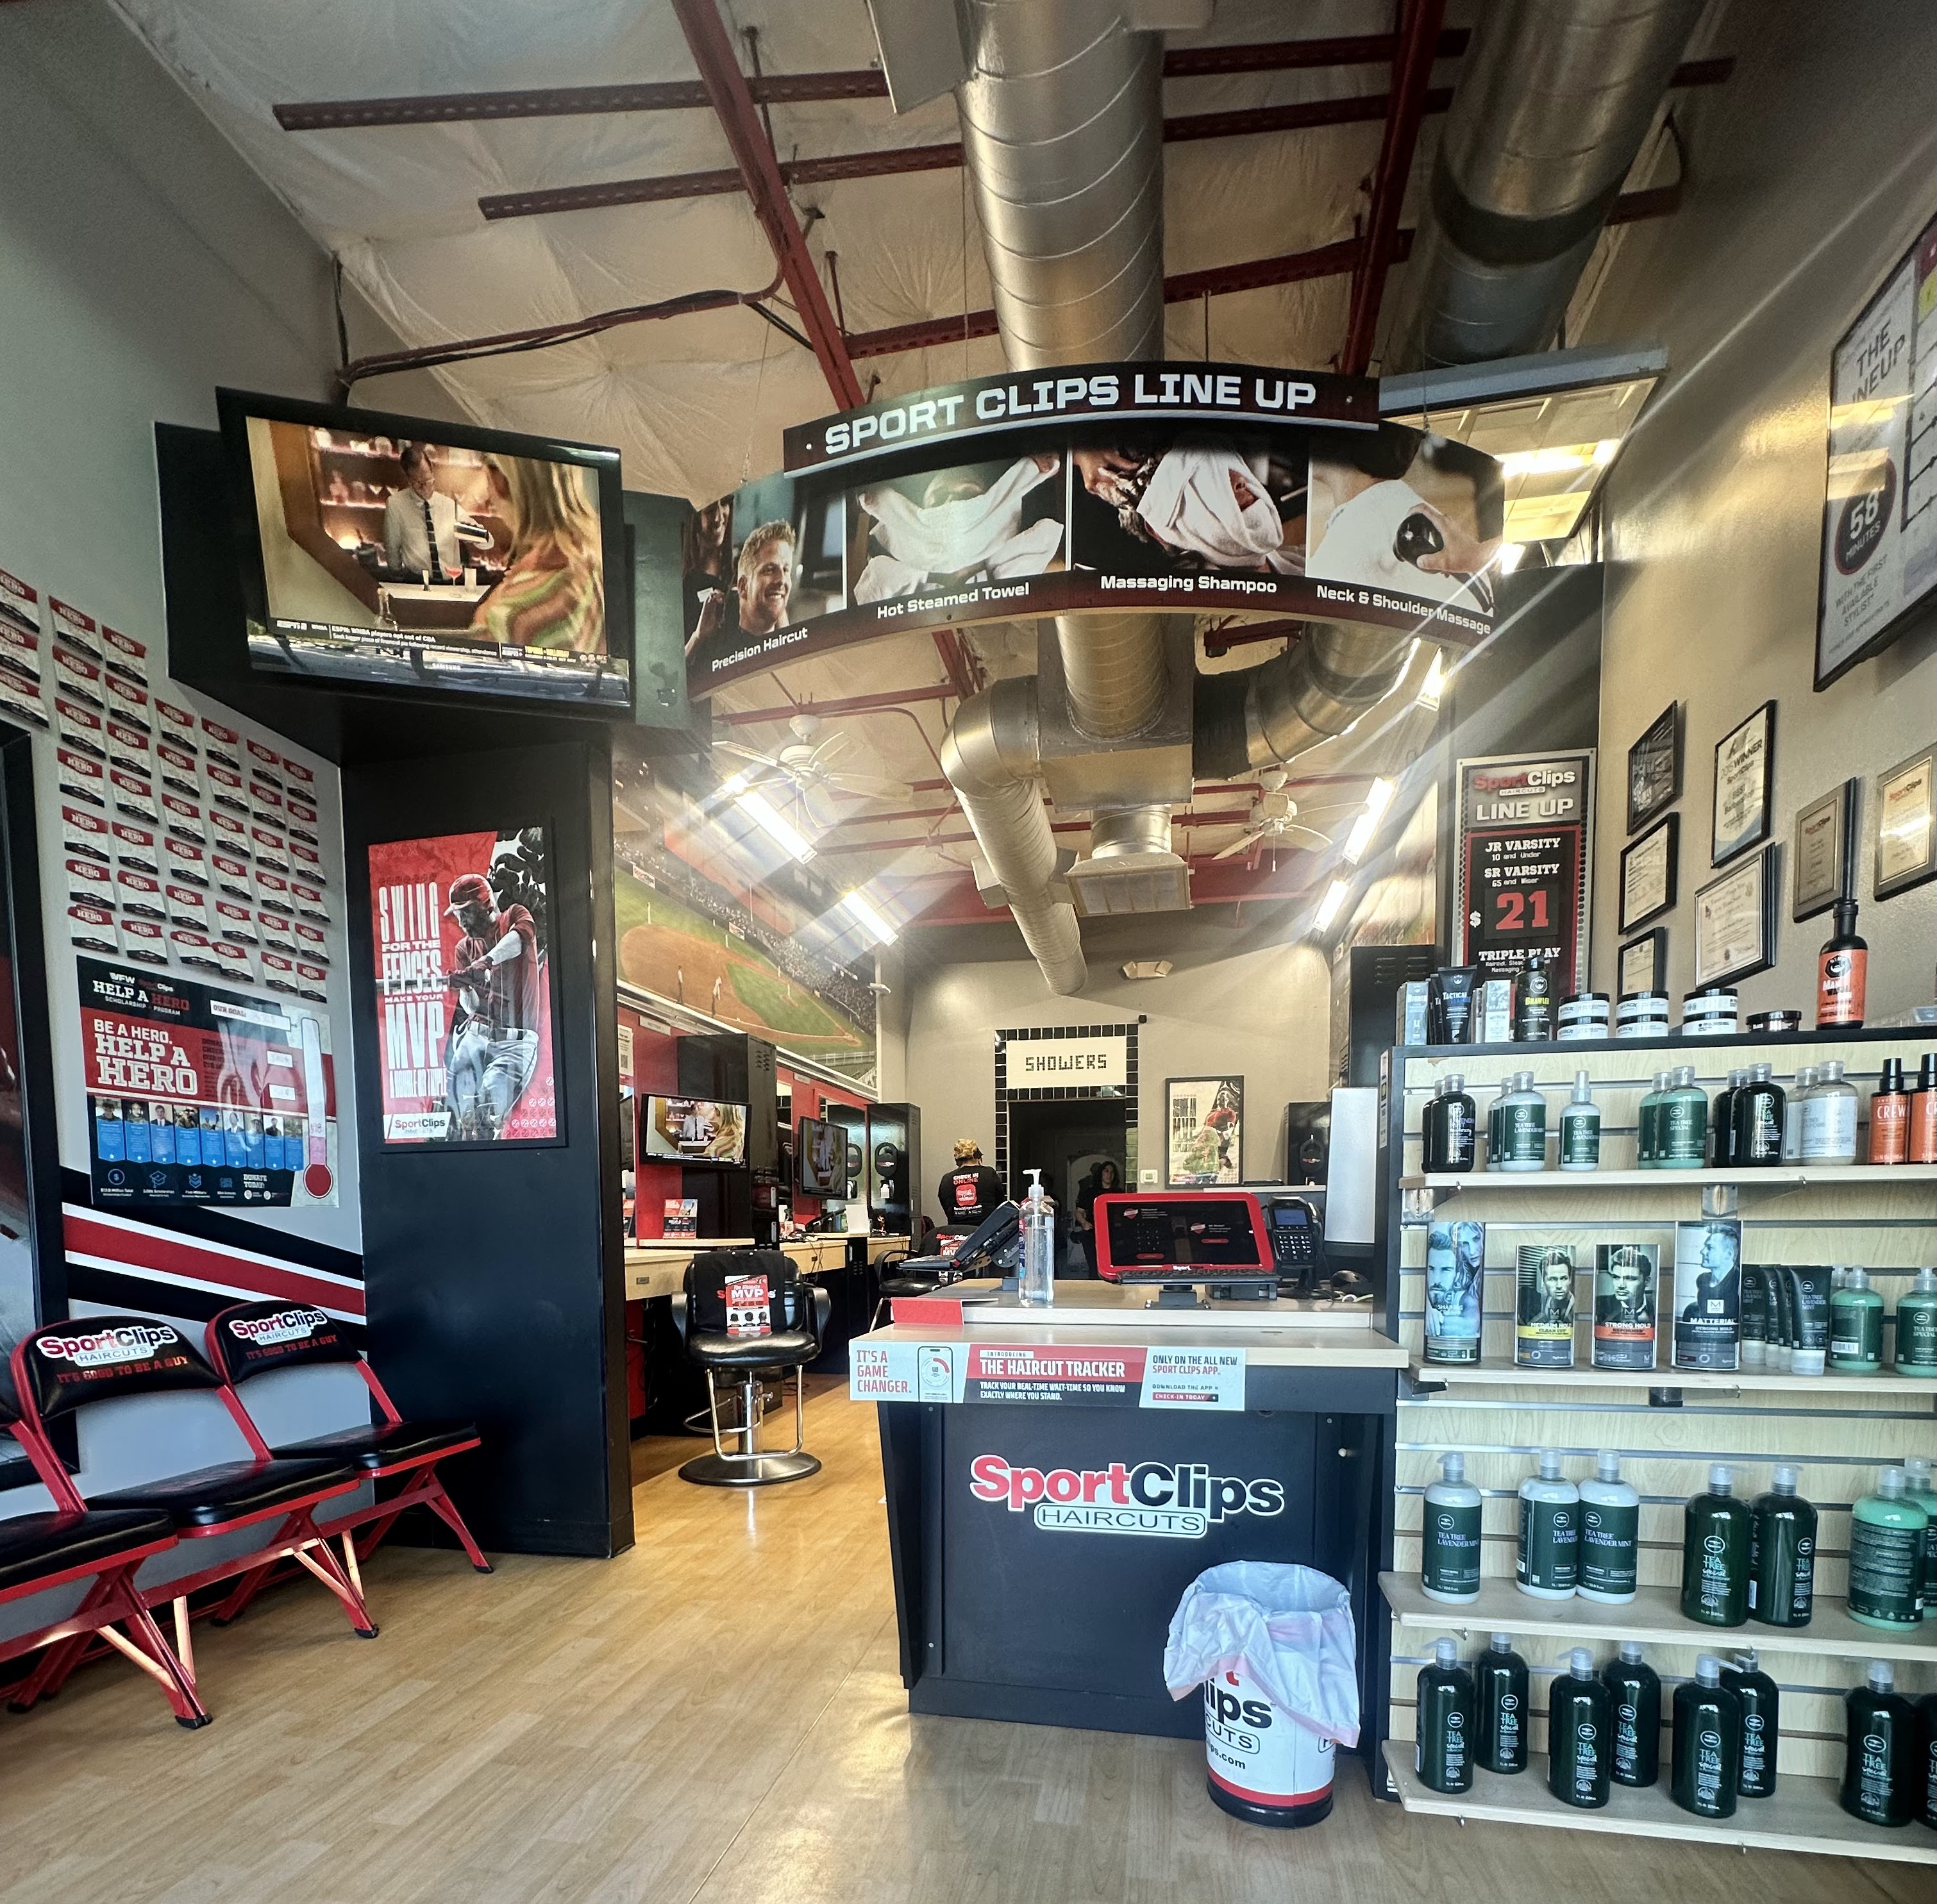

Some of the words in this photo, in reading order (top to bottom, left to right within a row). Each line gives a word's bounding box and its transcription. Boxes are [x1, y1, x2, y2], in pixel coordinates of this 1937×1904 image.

[1857, 319, 1891, 376] THE
[825, 396, 964, 455] SPORT
[976, 375, 1119, 419] CLIPS
[1134, 374, 1241, 405] LINE
[1255, 382, 1316, 410] UP
[1846, 519, 1881, 562] MINUTES
[1100, 576, 1194, 591] Massaging
[1198, 576, 1277, 594] Shampoo
[877, 602, 904, 619] Hot
[907, 588, 978, 613] Steamed
[982, 582, 1030, 601] Towel
[1316, 585, 1355, 603] Neck
[1359, 592, 1370, 604] &
[1373, 594, 1434, 617] Shoulder
[1436, 608, 1491, 635] Massage
[712, 643, 761, 672] Precision
[764, 627, 808, 651] Haircut
[1734, 739, 1763, 767] WINNER
[1475, 771, 1575, 792] SportClips
[1477, 802, 1529, 821] LINE
[1539, 799, 1573, 815] UP
[1485, 841, 1501, 852] JR
[1505, 838, 1561, 851] VARSITY
[1484, 867, 1500, 878] SR
[1504, 864, 1559, 877] VARSITY
[379, 881, 440, 943] SWING
[1470, 911, 1481, 928] $
[1496, 890, 1548, 930] 21
[382, 941, 411, 952] FOR
[412, 939, 441, 949] THE
[1479, 950, 1524, 961] TRIPLE
[92, 980, 134, 999] HELP
[137, 989, 149, 1003] A
[151, 992, 190, 1011] HERO
[105, 995, 147, 1009] SCHOLARSHIP
[153, 1005, 181, 1016] PROGRAM
[213, 1005, 228, 1013] OUR
[94, 1019, 114, 1034] BE
[117, 1024, 128, 1037] A
[131, 1026, 173, 1044] HERO.
[94, 1033, 165, 1062] HELP
[170, 1046, 190, 1067] A
[1026, 1054, 1107, 1071] SHOWERS
[96, 1055, 198, 1096] HERO
[1877, 1101, 1906, 1119] CREW
[394, 1118, 446, 1130] SportClips
[731, 1289, 764, 1298] MVP
[232, 1312, 326, 1338] SportClips
[258, 1326, 308, 1342] HAIRCUTS
[40, 1327, 175, 1357] SportClips
[263, 1347, 283, 1358] GOOD
[285, 1345, 297, 1355] TO
[298, 1342, 310, 1353] BE
[312, 1340, 320, 1349] A
[321, 1335, 338, 1347] GUY
[78, 1347, 149, 1363] HAIRCUTS
[857, 1350, 878, 1362] IT'S
[880, 1351, 887, 1363] A
[1153, 1355, 1173, 1364] ONLY
[1175, 1355, 1186, 1364] ON
[1187, 1356, 1202, 1364] THE
[1204, 1357, 1218, 1365] ALL
[1220, 1357, 1237, 1365] NEW
[58, 1371, 81, 1383] IT'S
[83, 1367, 114, 1381] GOOD
[116, 1366, 132, 1377] TO
[135, 1364, 151, 1375] BE
[154, 1362, 164, 1372] A
[165, 1355, 189, 1369] GUY
[857, 1365, 888, 1378] GAME
[980, 1359, 1003, 1374] THE
[1007, 1359, 1064, 1376] HAIRCUT
[1066, 1361, 1125, 1377] TRACKER
[1152, 1365, 1177, 1374] SPORT
[1179, 1365, 1200, 1374] CLIPS
[1202, 1366, 1220, 1375] APP.
[857, 1380, 912, 1393] CHANGER.
[980, 1390, 1003, 1399] EXACTLY
[1005, 1391, 1026, 1399] WHERE
[1039, 1392, 1062, 1401] STAND.
[1000, 1382, 1016, 1390] YOUR
[1017, 1382, 1048, 1391] REAL-TIME
[1049, 1383, 1082, 1392] WAIT-TIME
[1092, 1384, 1105, 1392] YOU
[1106, 1385, 1125, 1393] KNOW
[973, 1456, 1283, 1519] SportClips
[1042, 1508, 1200, 1530] HAIRCUTS
[1438, 1539, 1469, 1547] LAVENDER
[1585, 1535, 1617, 1546] LAVENDER
